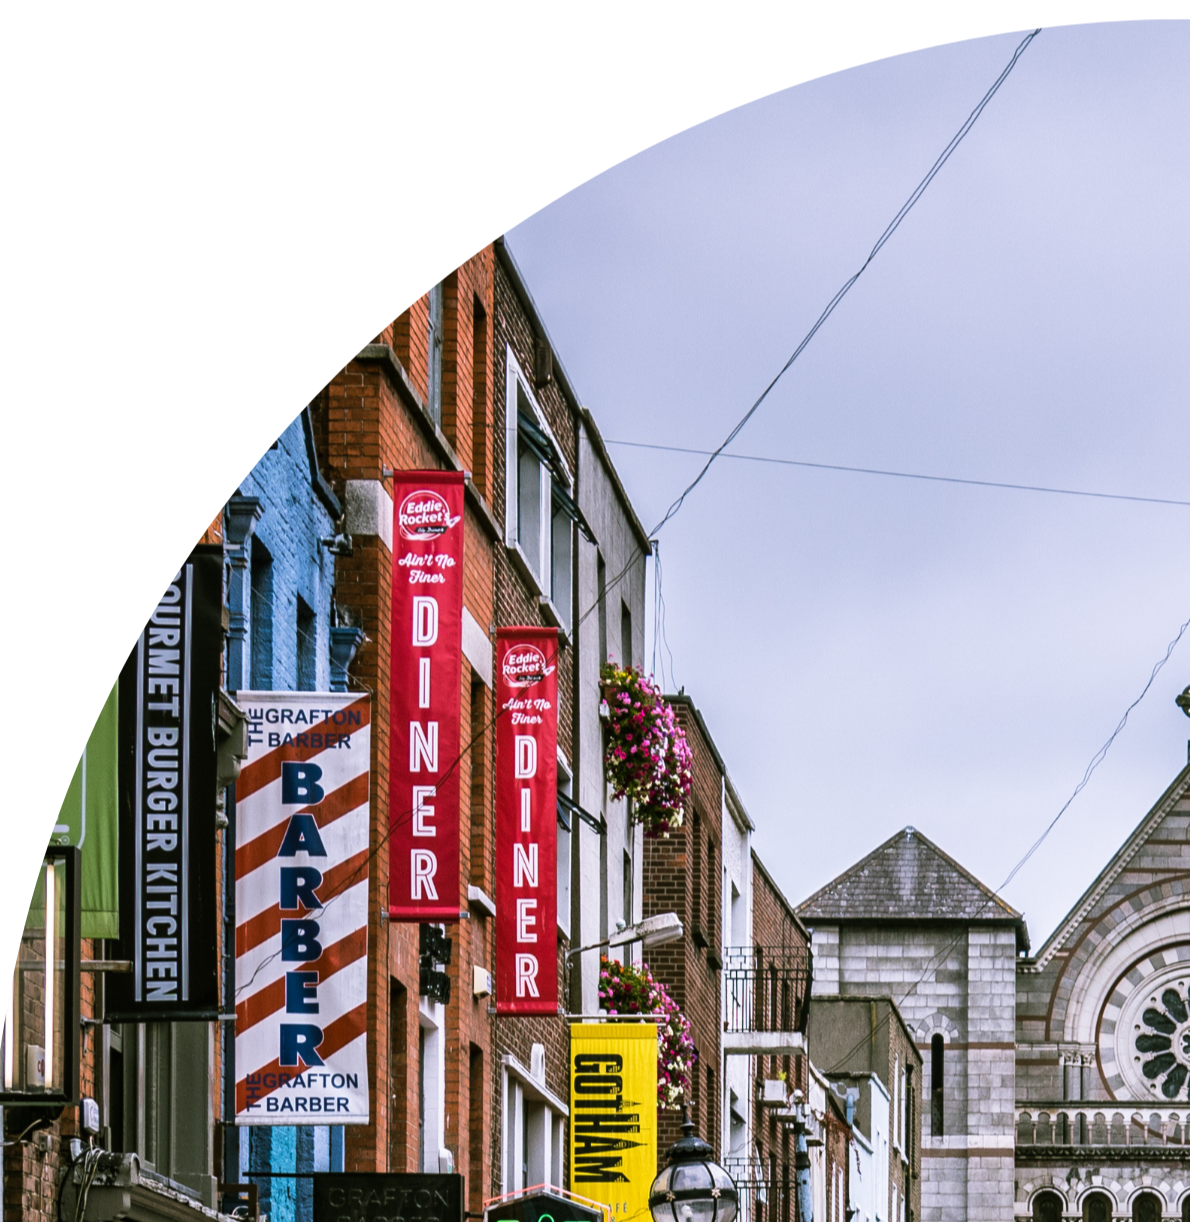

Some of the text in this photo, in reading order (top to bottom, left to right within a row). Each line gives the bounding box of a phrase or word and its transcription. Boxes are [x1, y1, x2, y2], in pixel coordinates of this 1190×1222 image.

[407, 500, 443, 514] Eddie
[399, 511, 450, 526] Rocket's
[398, 553, 456, 569] Ain't No
[409, 569, 445, 584] Finer
[508, 652, 539, 665] Eddie
[502, 698, 552, 711] Ain't No
[265, 708, 361, 725] GRAFTON
[511, 712, 543, 725] Finer
[248, 708, 263, 747] THE
[269, 732, 351, 749] BARBER
[410, 596, 439, 900] DINER
[146, 567, 181, 1001] OURMET BURGER KITCHEN
[514, 735, 540, 997] DINER
[277, 761, 328, 1066] BARBER
[263, 1073, 358, 1089] GRAFTON
[246, 1074, 261, 1112] THE
[266, 1097, 350, 1112] BARBER
[574, 1053, 644, 1183] GOTHAM
[328, 1188, 449, 1208] GRAFTON
